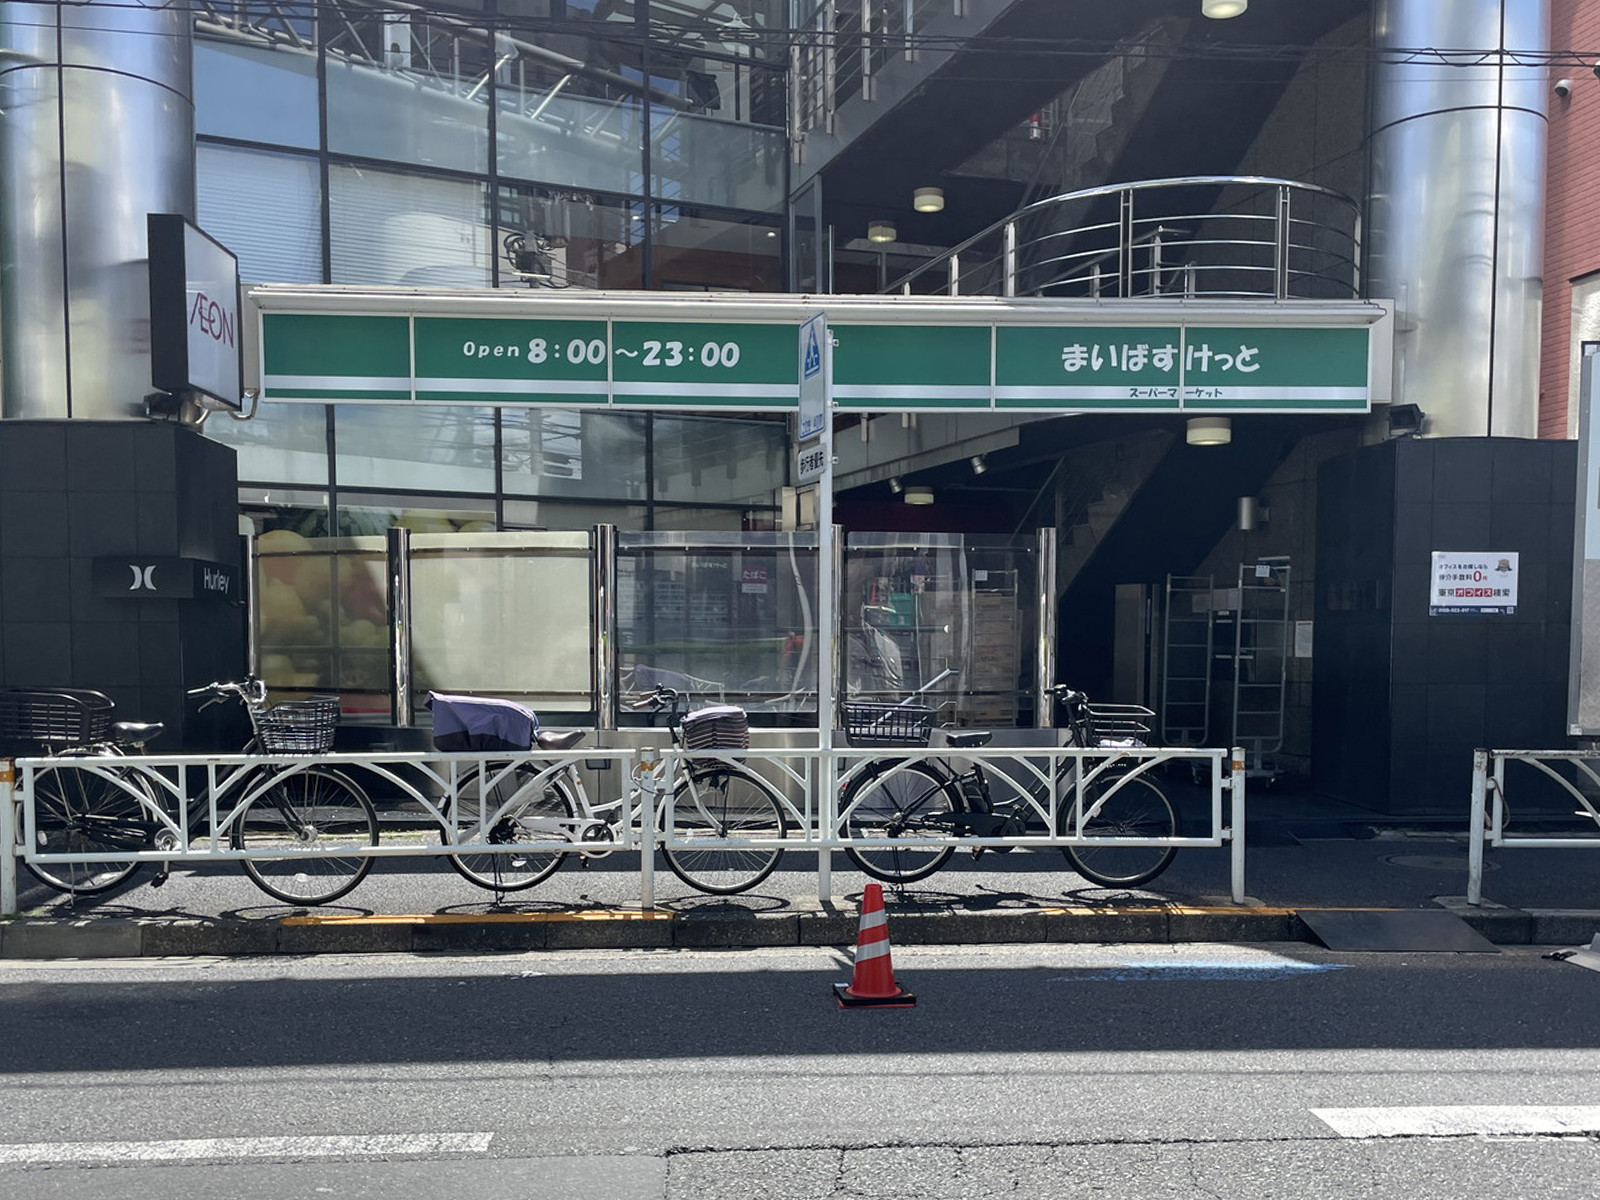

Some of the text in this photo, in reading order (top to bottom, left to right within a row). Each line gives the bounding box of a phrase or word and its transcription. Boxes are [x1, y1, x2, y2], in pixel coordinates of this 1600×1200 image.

[463, 341, 520, 358] Open
[1061, 343, 1260, 373] まいばすけっと
[1129, 387, 1223, 399] スーパーマーケット
[203, 567, 229, 594] Hurley
